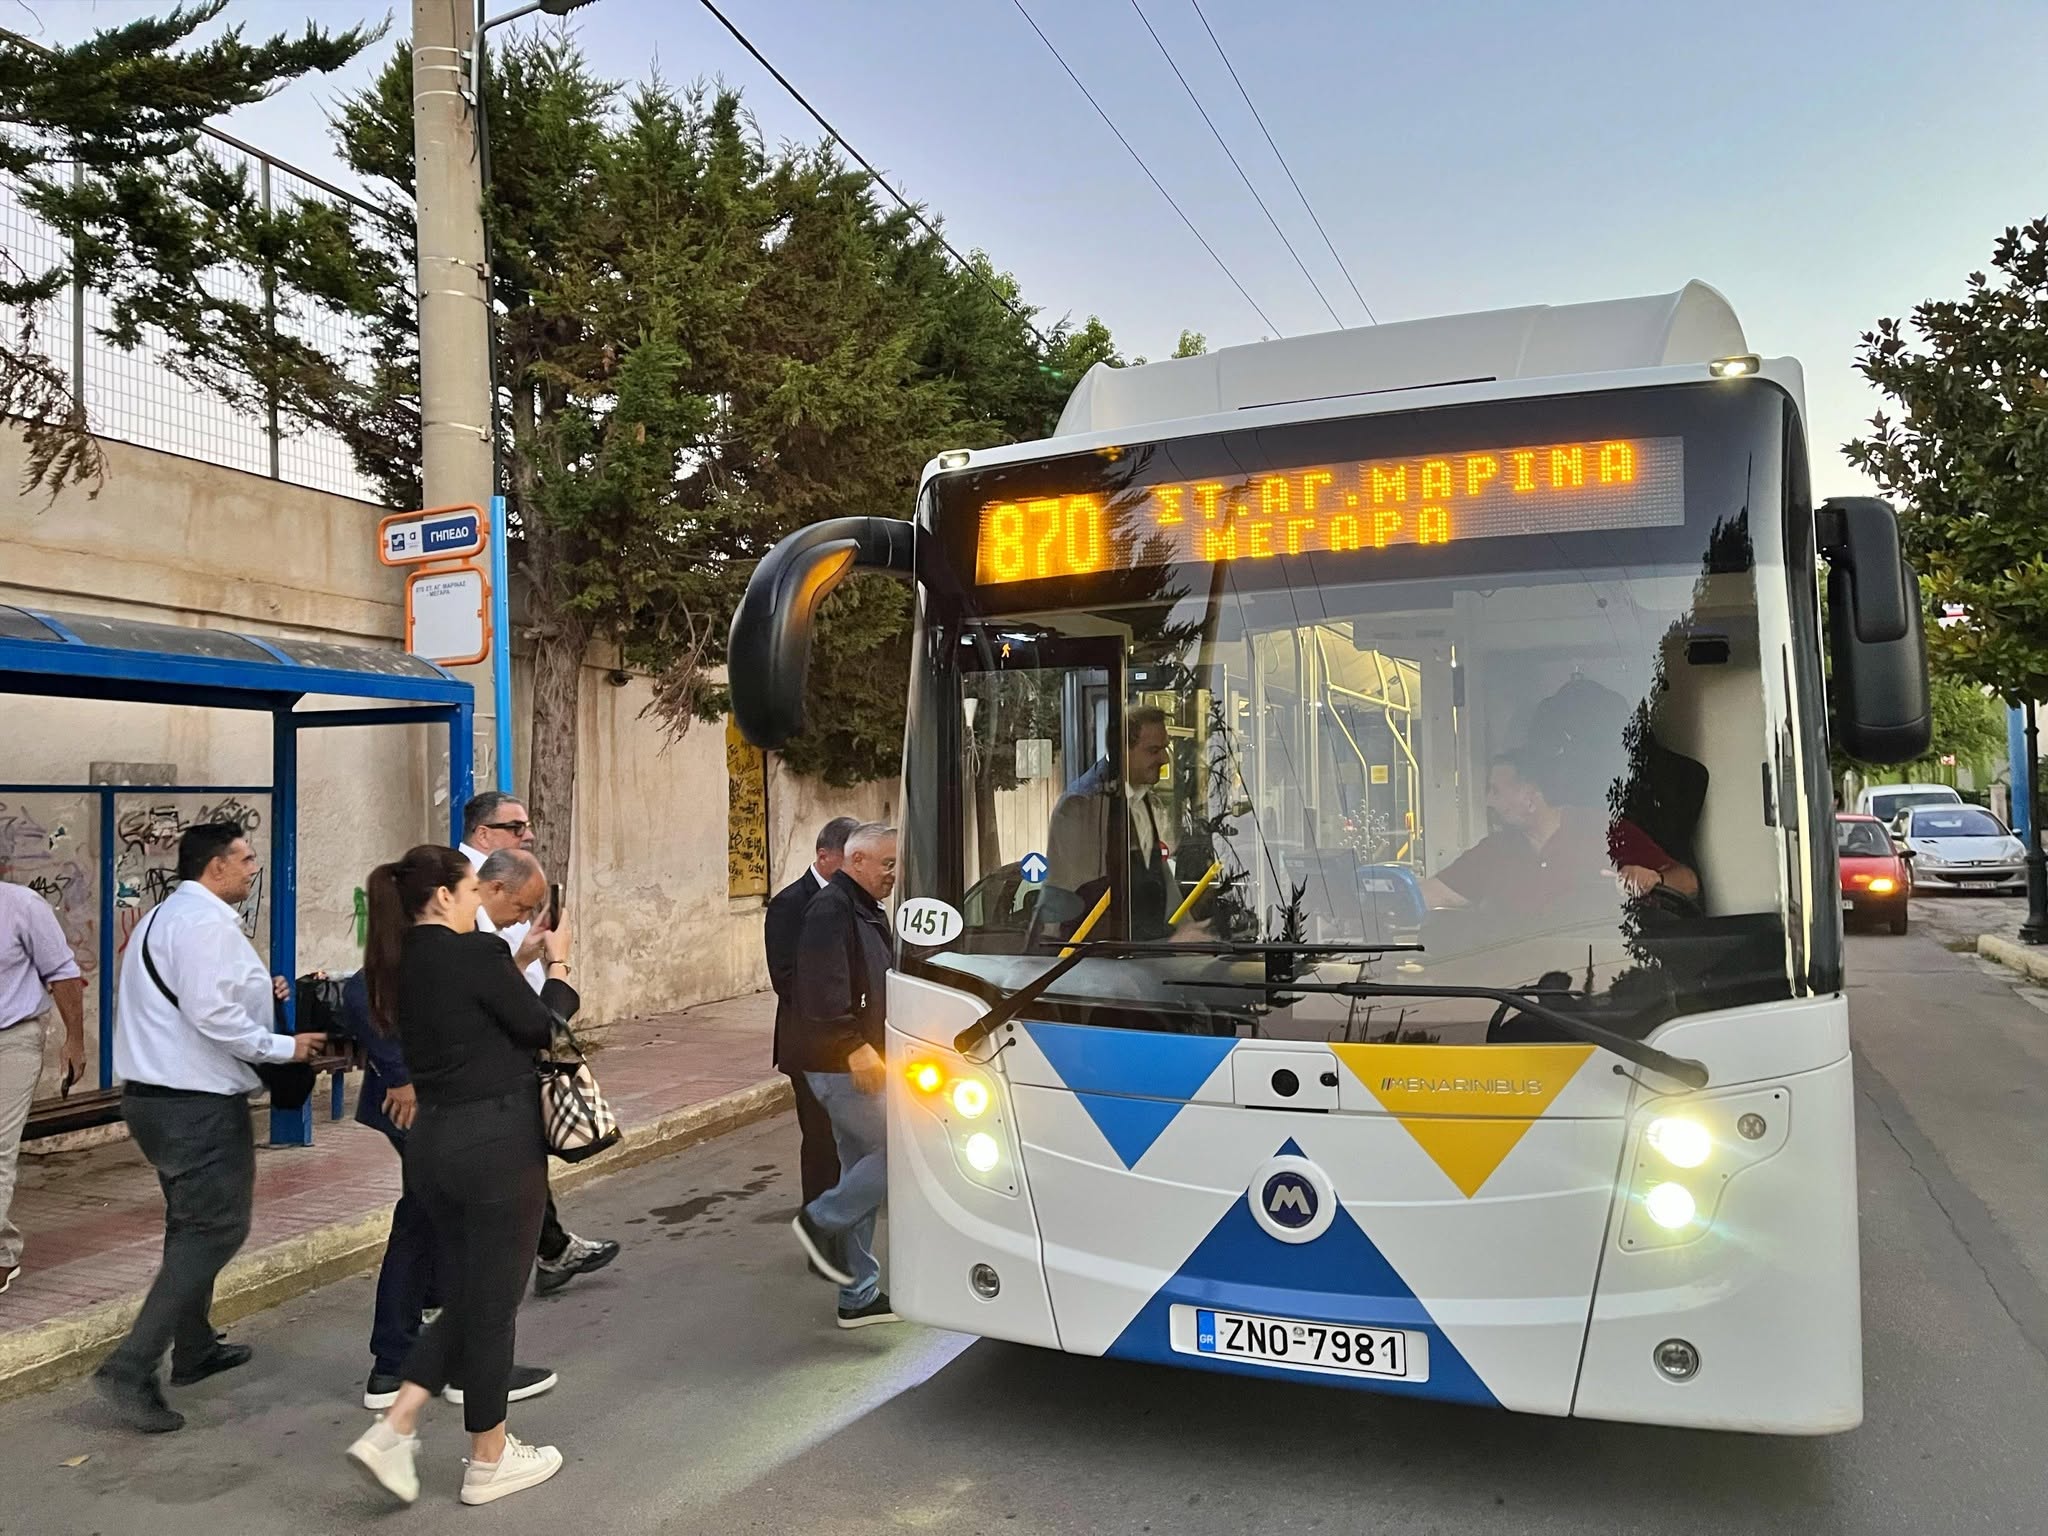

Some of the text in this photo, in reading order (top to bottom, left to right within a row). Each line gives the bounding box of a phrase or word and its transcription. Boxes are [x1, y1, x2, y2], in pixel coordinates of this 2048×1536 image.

[431, 526, 469, 543] ΓΗΠΕΔΟ
[992, 496, 1098, 578] 870
[1204, 506, 1450, 562] ΜΕΓΑΡΑ
[903, 908, 949, 937] 1451
[1391, 1077, 1543, 1095] MENARINIBUS
[1268, 1184, 1312, 1215] M
[1199, 1334, 1214, 1345] GR
[1224, 1317, 1397, 1370] ZNO-7981
